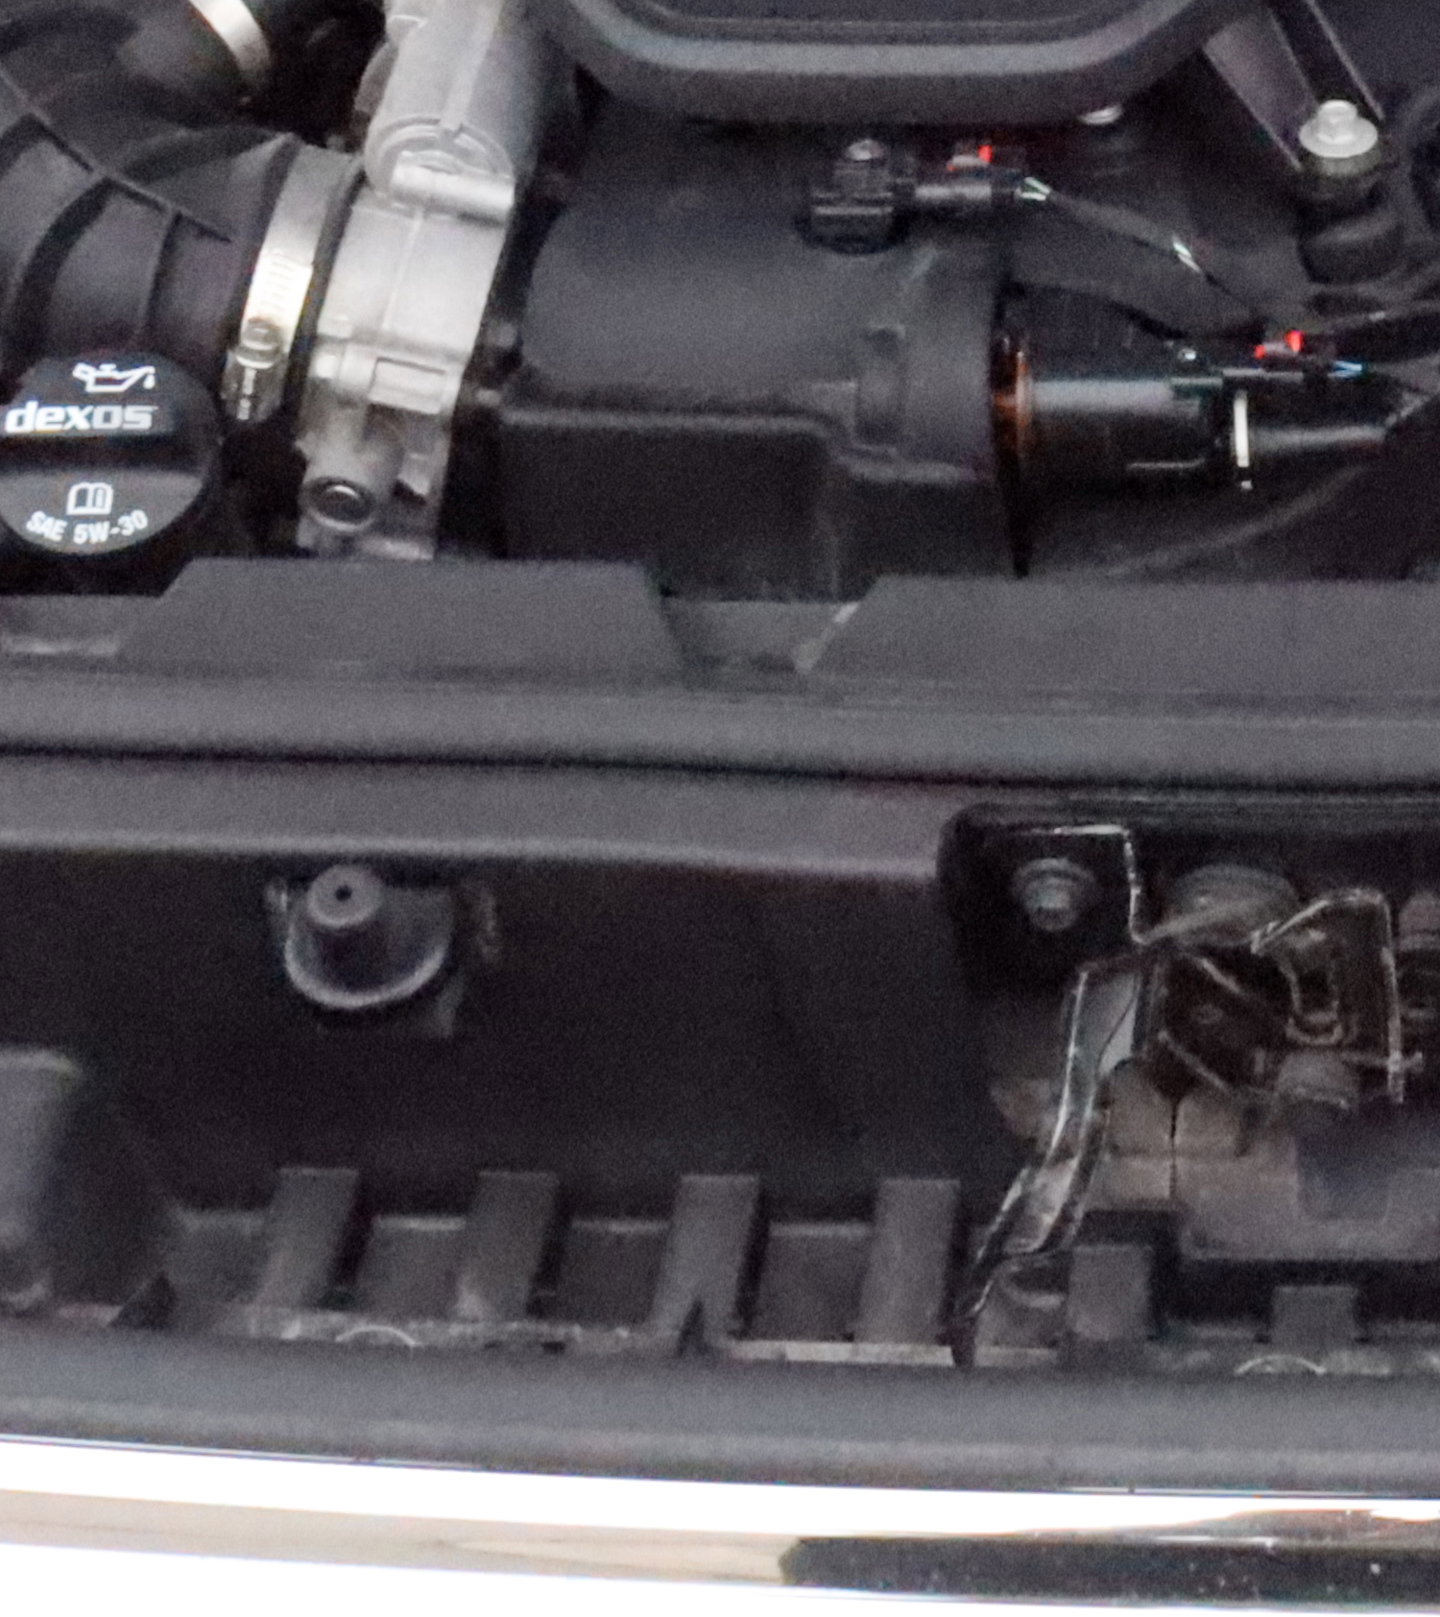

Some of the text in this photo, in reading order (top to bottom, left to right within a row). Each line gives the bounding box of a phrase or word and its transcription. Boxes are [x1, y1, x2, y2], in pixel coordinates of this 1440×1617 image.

[5, 401, 158, 434] dexos
[26, 509, 149, 544] SAE 5W-30
